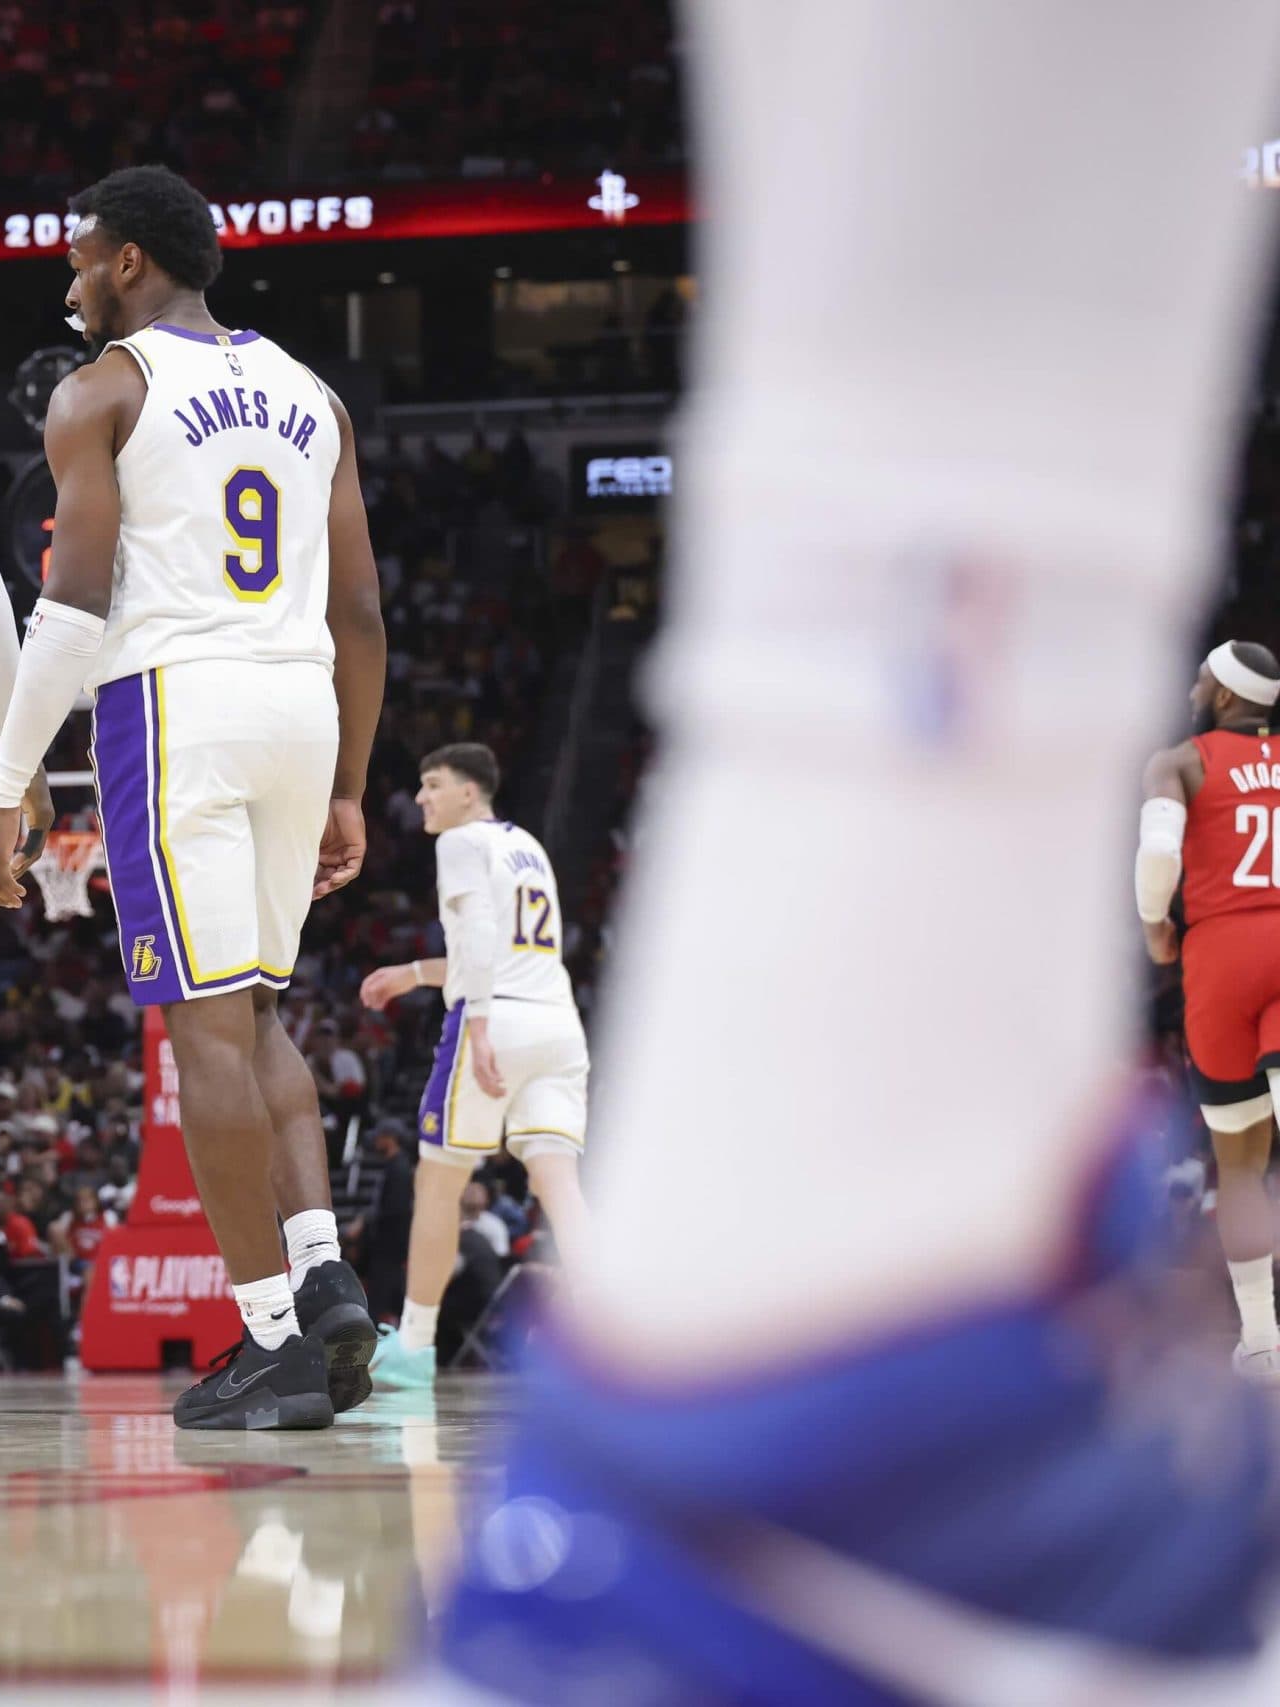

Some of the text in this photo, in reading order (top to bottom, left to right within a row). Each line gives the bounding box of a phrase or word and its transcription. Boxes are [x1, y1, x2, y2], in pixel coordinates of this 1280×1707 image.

[206, 196, 374, 237] AYOFFS
[173, 387, 318, 459] JAMES JR.
[222, 464, 283, 603] 9
[1232, 803, 1280, 889] 2
[512, 884, 557, 954] 12
